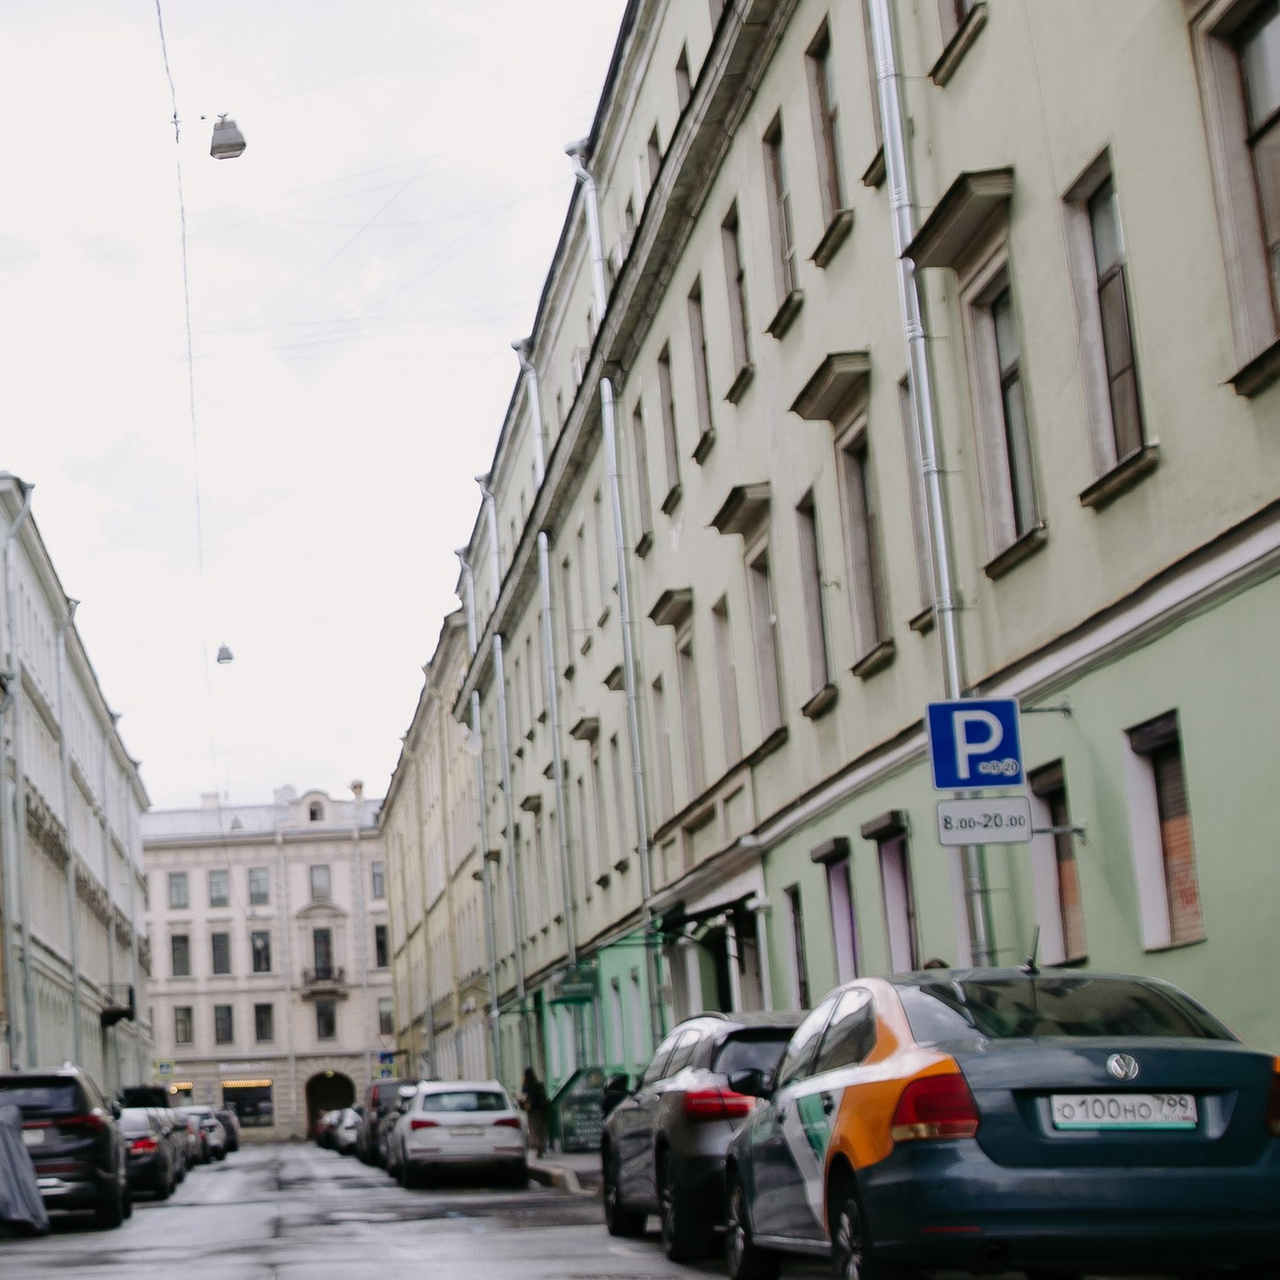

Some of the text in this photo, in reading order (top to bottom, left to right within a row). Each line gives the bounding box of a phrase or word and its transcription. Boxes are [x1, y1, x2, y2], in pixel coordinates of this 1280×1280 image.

[953, 709, 1004, 779] P
[1004, 761, 1018, 772] 20
[1153, 1094, 1189, 1114] 799
